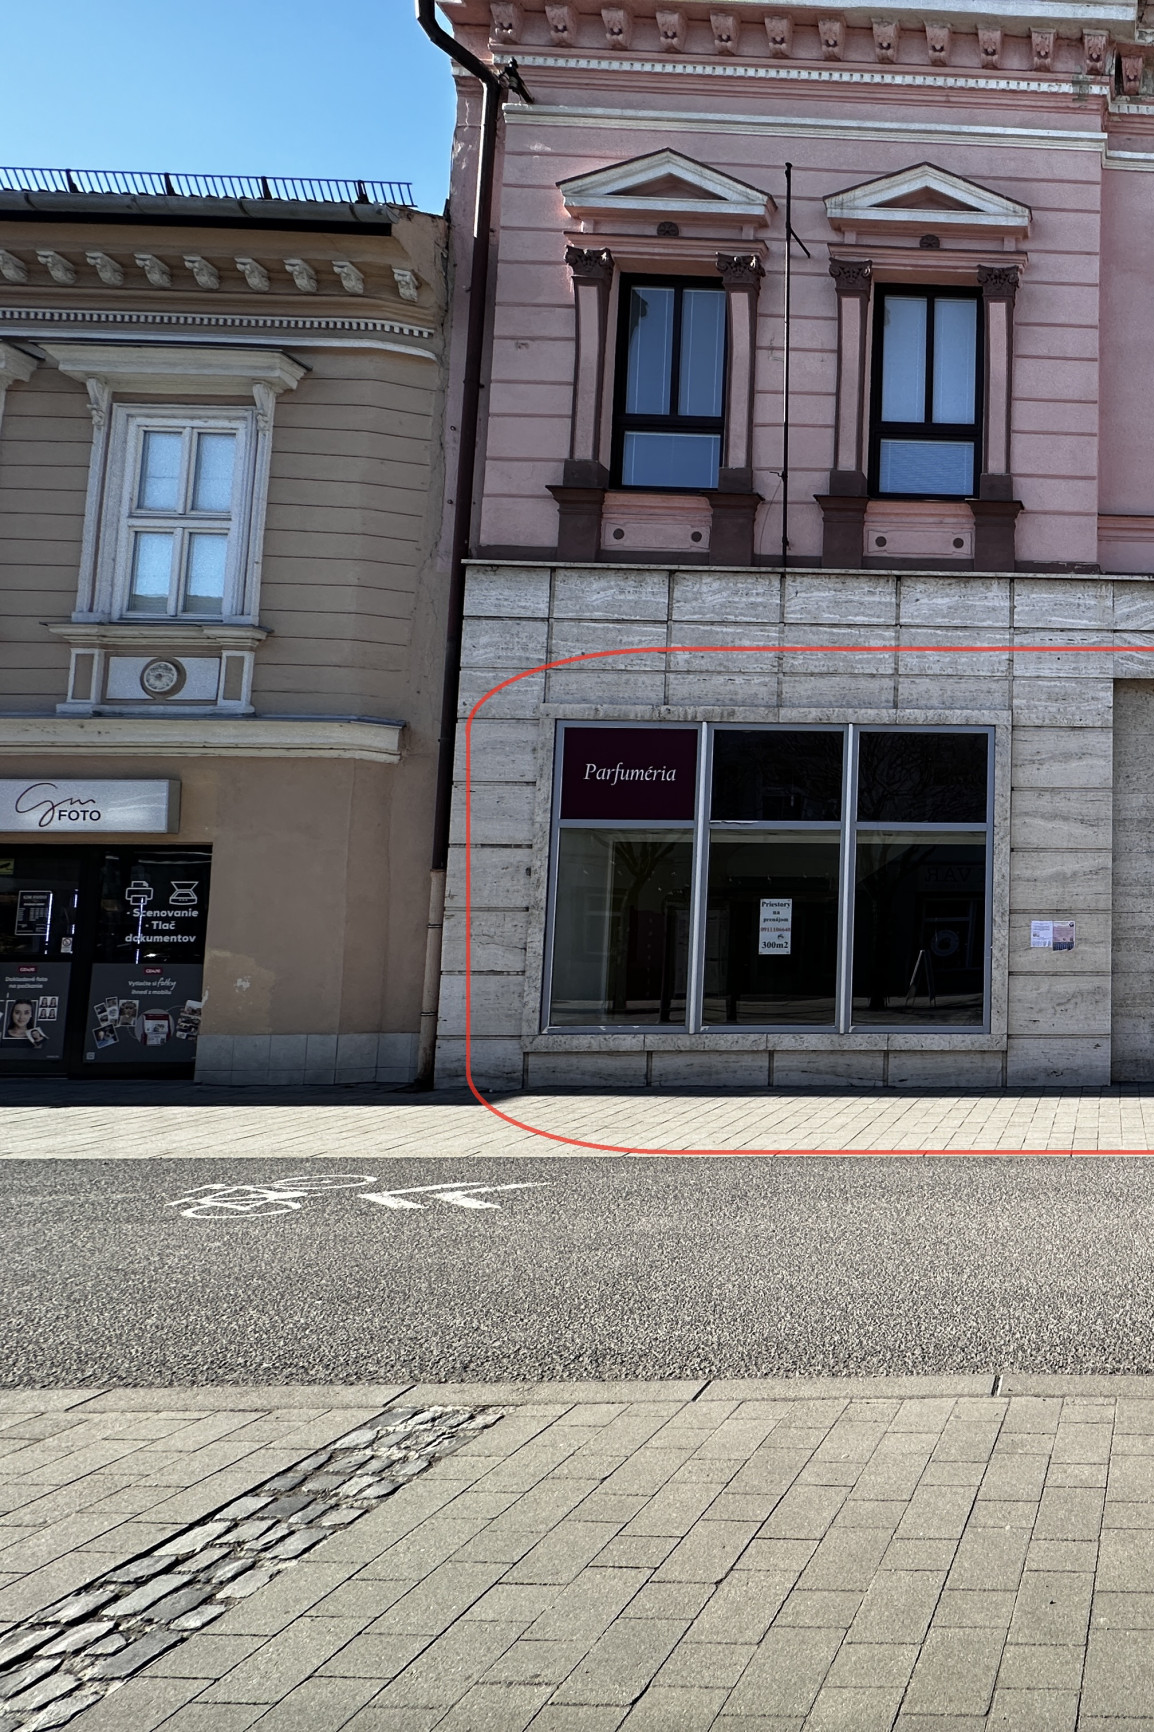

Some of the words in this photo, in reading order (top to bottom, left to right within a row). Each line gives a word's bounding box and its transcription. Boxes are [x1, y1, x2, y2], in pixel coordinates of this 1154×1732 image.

[584, 762, 677, 785] Parfuméria
[58, 810, 101, 821] FOTO
[151, 921, 176, 930] Tlač
[125, 933, 196, 943] dokumentov
[761, 941, 789, 949] 300m2
